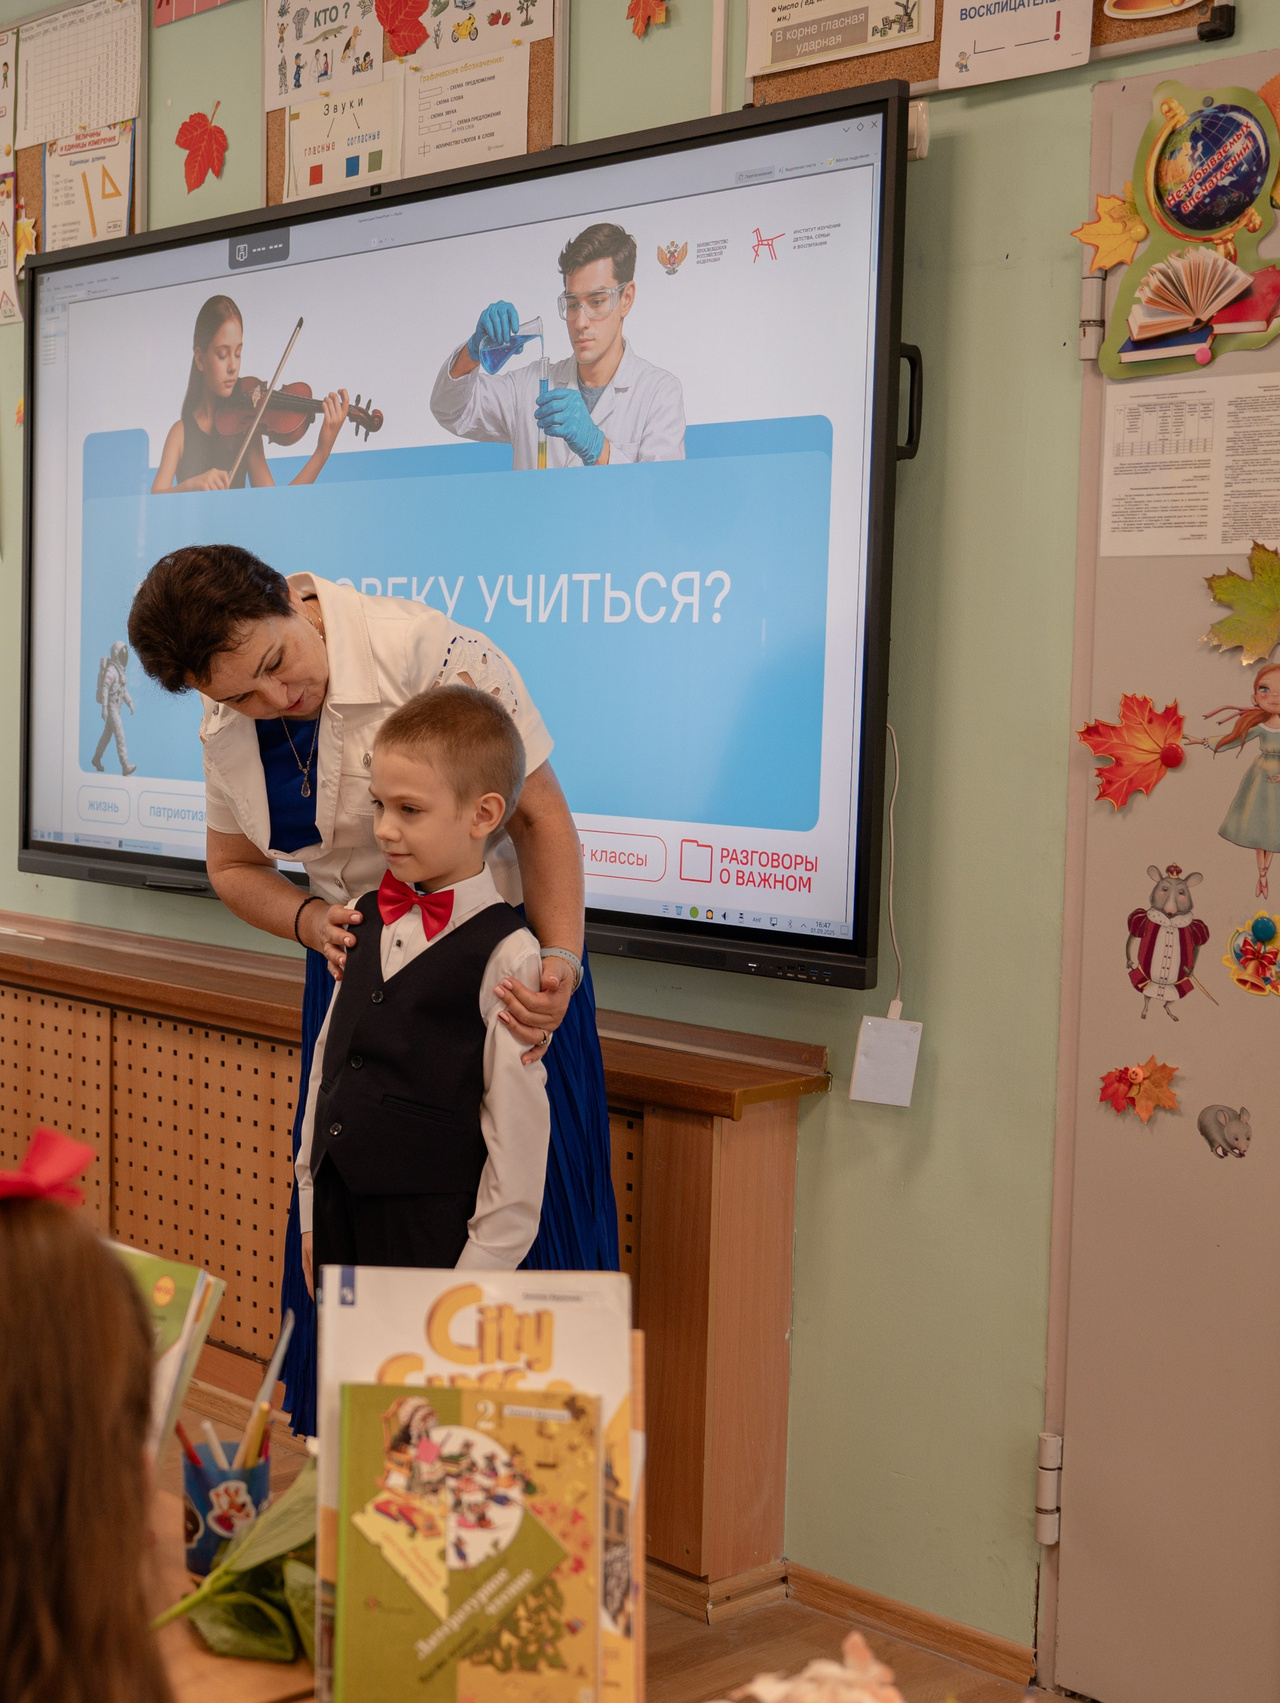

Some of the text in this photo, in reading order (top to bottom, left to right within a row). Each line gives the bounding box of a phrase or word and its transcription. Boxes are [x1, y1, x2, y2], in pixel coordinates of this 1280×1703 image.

[778, 2, 799, 12] Число
[313, 5, 339, 28] КТО
[775, 12, 865, 42] В корне гласная
[795, 34, 842, 56] ударная
[420, 56, 505, 83] Графические обозначения:
[450, 75, 496, 91] СХЕМА ПРЕДЛОЖЕНИЯ
[323, 97, 364, 116] Звуки
[436, 95, 464, 106] СХЕМА СЛОВА
[457, 111, 502, 126] СХЕМА ПРЕДЛОЖЕНИЯ
[64, 142, 87, 151] ЕДИНИЦЫ
[88, 135, 117, 148] ИЗМЕРЕНИЯ
[75, 130, 102, 142] ВЕЛИЧИНЫ
[346, 130, 381, 147] согласные
[435, 139, 461, 149] КОЛИЧЕСТВО
[461, 136, 477, 145] СЛОГОВ
[482, 131, 495, 139] СЛОВЕ
[304, 141, 336, 158] гласные
[69, 154, 107, 166] Единицы длины
[1165, 121, 1252, 208] Незабываемых
[1181, 135, 1254, 213] впечатлений!
[793, 223, 842, 234] ИНСТИТУТ ИЗУЧЕНИЯ
[797, 241, 828, 249] ВОСПИТАНИЯ
[477, 570, 732, 624] УЧИТЬСЯ?
[87, 799, 207, 822] жизнь патриотиз
[590, 847, 648, 867] классы
[720, 847, 818, 873] РАЗГОВОРЫ
[720, 868, 812, 893] О ВАЖНОМ
[810, 927, 835, 936] 01.09.2025
[815, 921, 831, 929] 16:47
[425, 1281, 554, 1373] City
